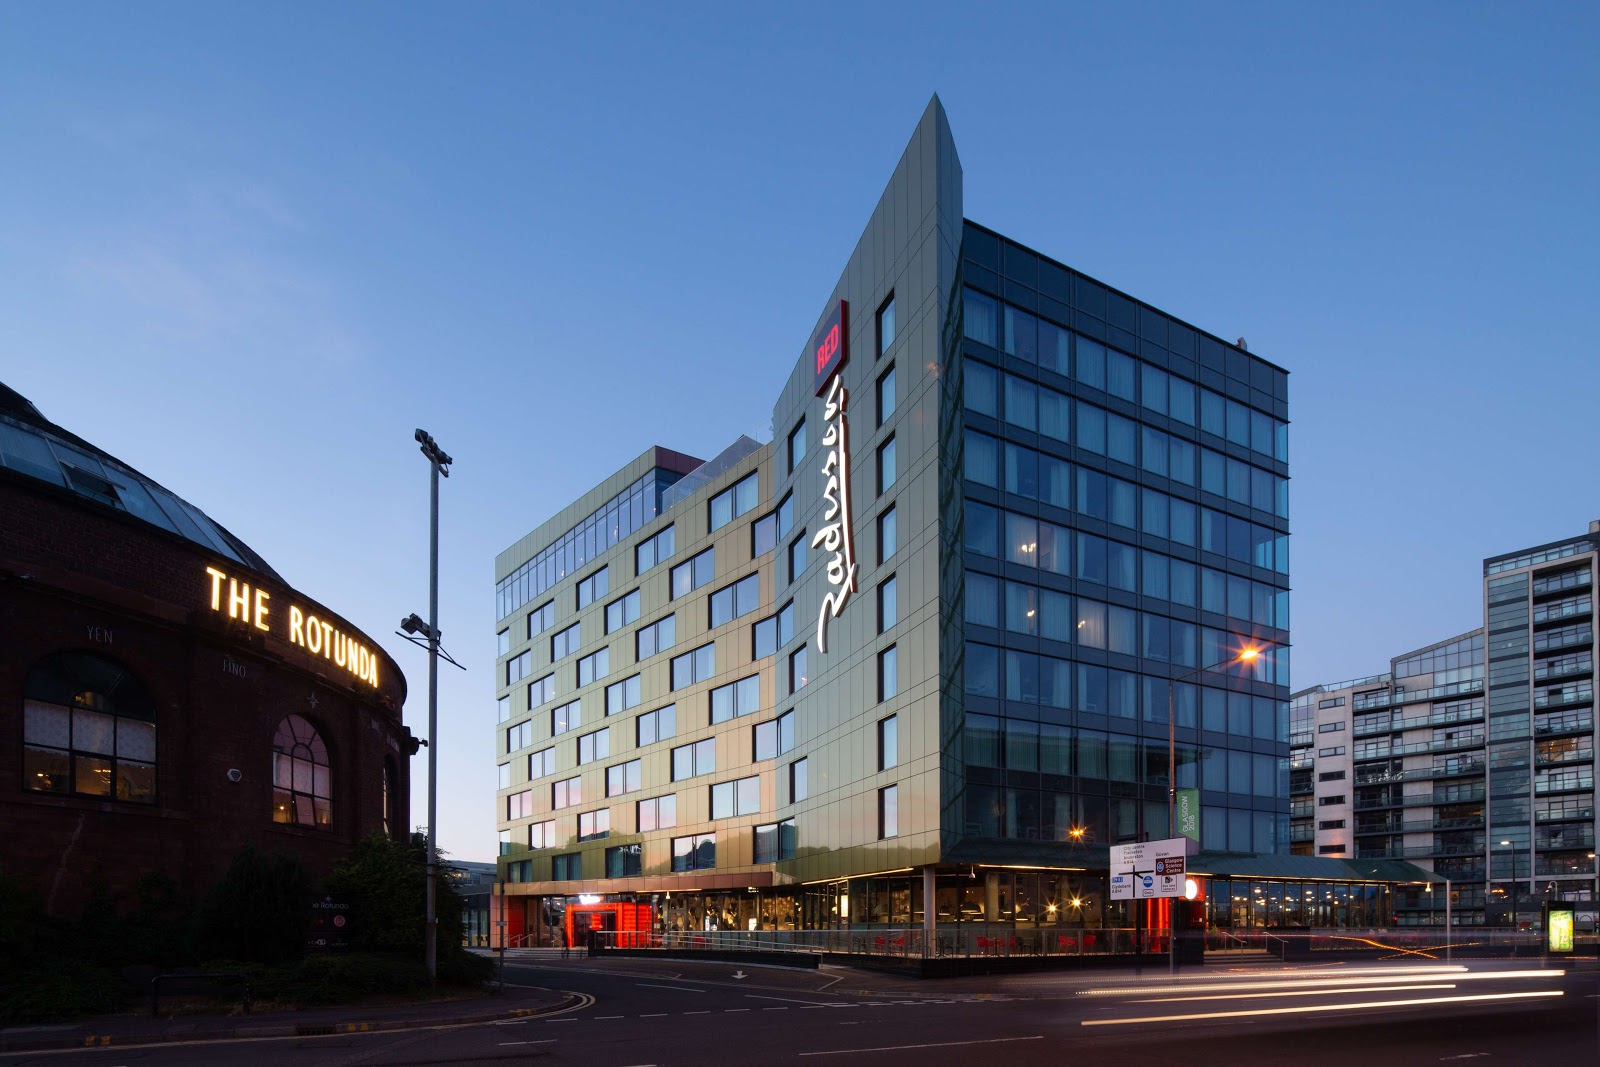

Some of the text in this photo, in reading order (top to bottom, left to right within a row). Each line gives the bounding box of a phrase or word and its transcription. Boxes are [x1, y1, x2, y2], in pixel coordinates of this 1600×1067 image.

[817, 323, 839, 375] RED
[812, 374, 857, 654] Radisson
[86, 625, 113, 644] YEN
[206, 566, 379, 689] THE ROTUNDA
[222, 659, 247, 678] FINO
